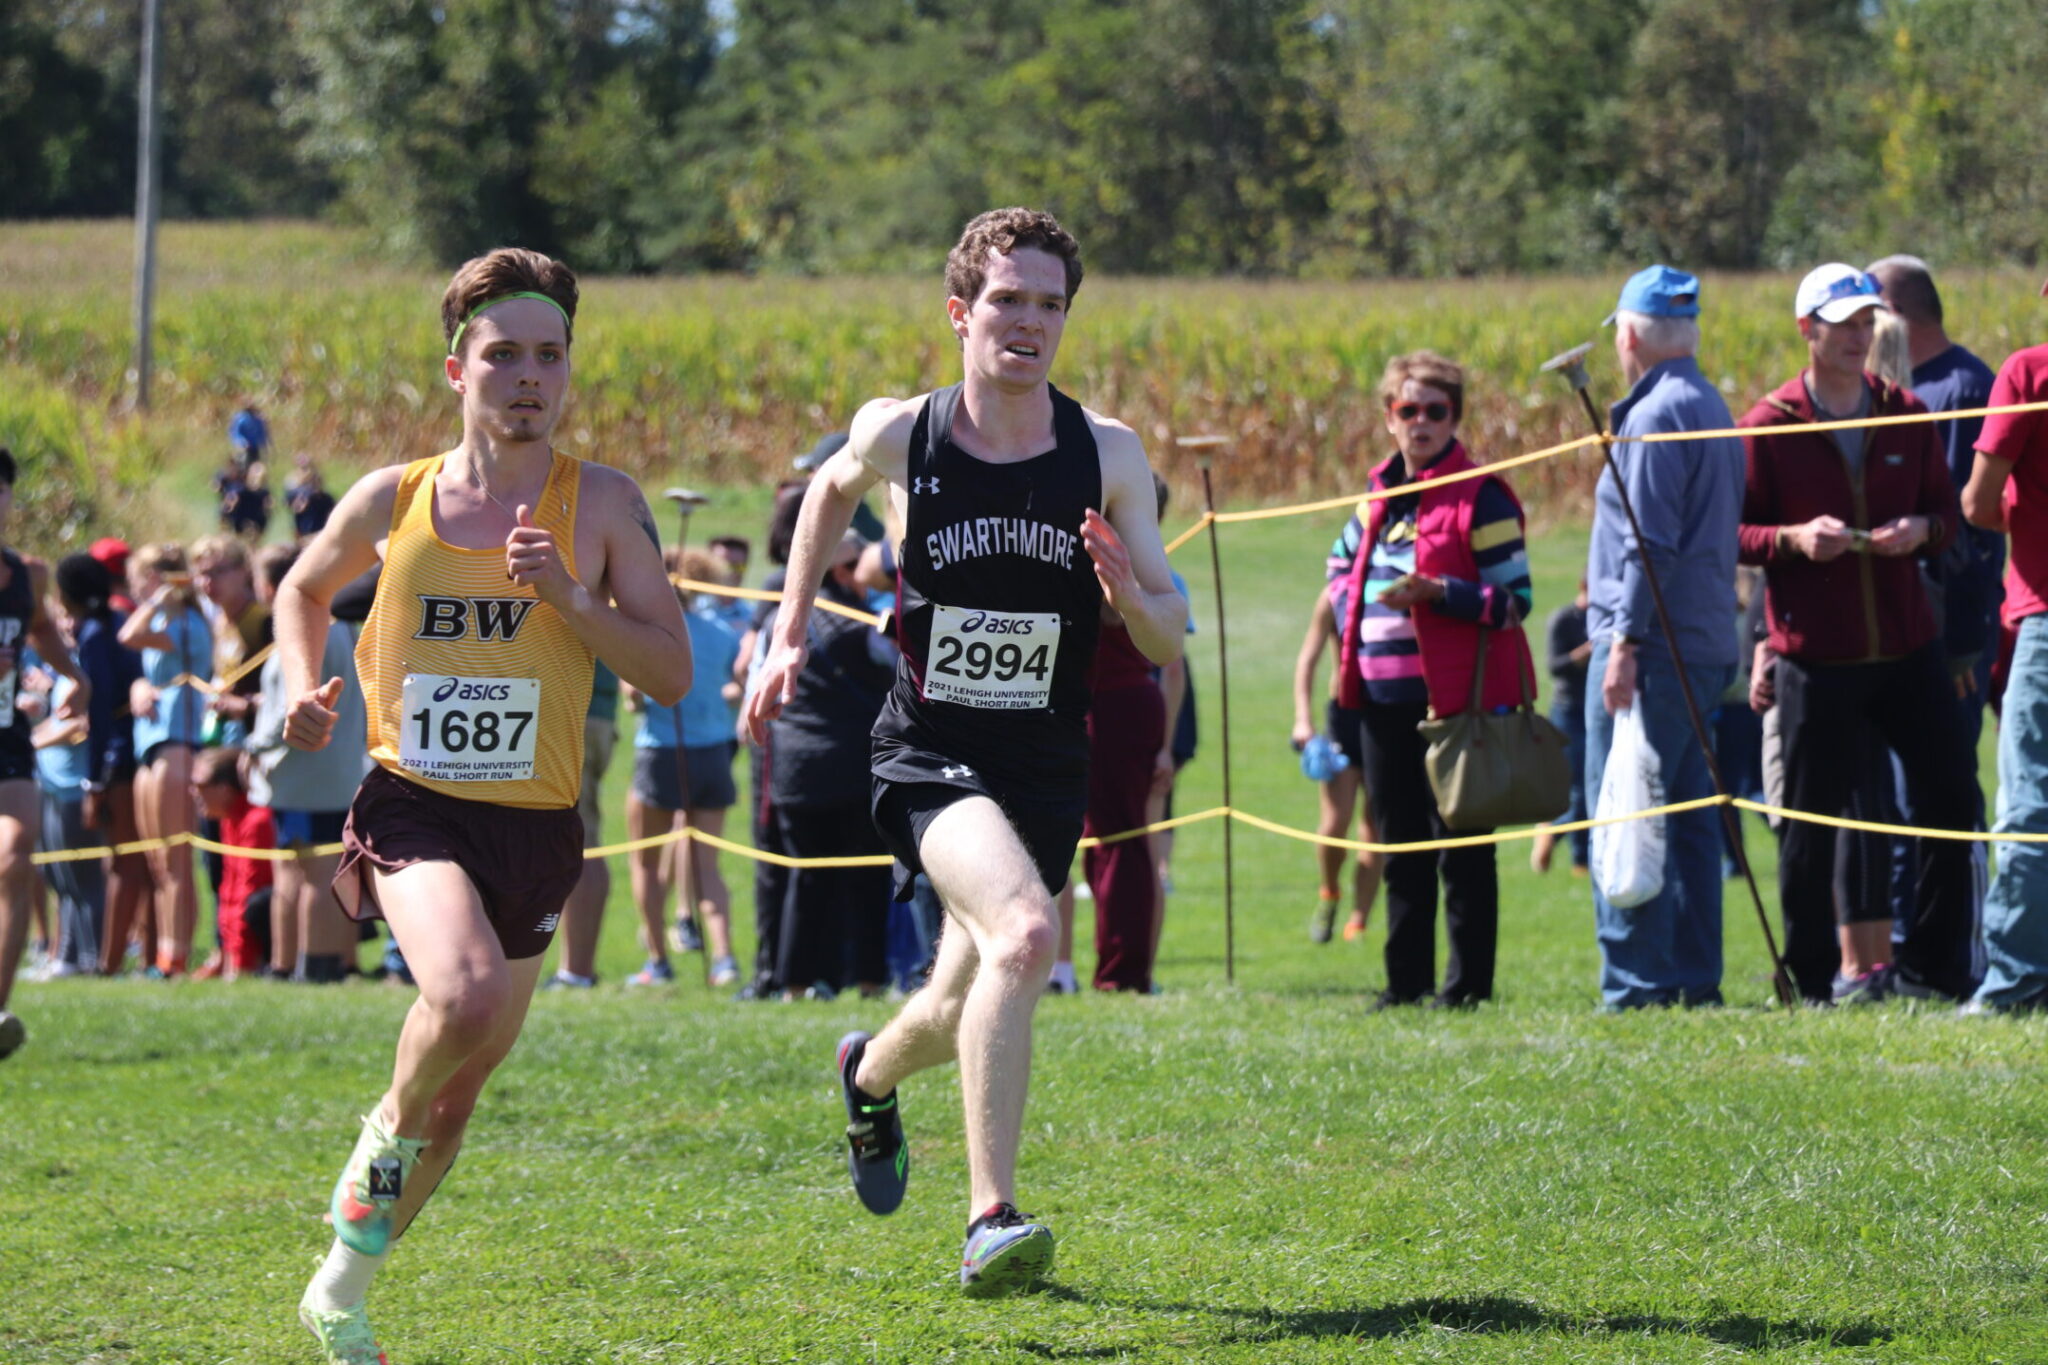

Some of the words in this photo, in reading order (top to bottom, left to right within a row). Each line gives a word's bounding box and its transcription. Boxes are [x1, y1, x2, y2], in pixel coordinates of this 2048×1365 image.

[927, 517, 1077, 571] SWARTHMORE
[411, 594, 541, 641] BW
[985, 617, 1034, 635] asics
[0, 617, 21, 646] P
[934, 636, 1049, 681] 2994
[458, 684, 510, 701] asics
[928, 681, 951, 692] 2021
[954, 686, 992, 698] LEHIGH
[994, 690, 1048, 699] UNIVERSITY
[946, 693, 972, 706] PAUL
[975, 699, 1008, 708] SHORT
[1010, 700, 1031, 708] RUN
[412, 708, 533, 752] 1687
[402, 758, 428, 768] 2021
[431, 761, 471, 770] LEHIGH
[473, 760, 533, 770] UNIVERSITY
[422, 770, 450, 780] PAUL
[453, 771, 488, 780] SHORT
[490, 771, 513, 780] RUN
